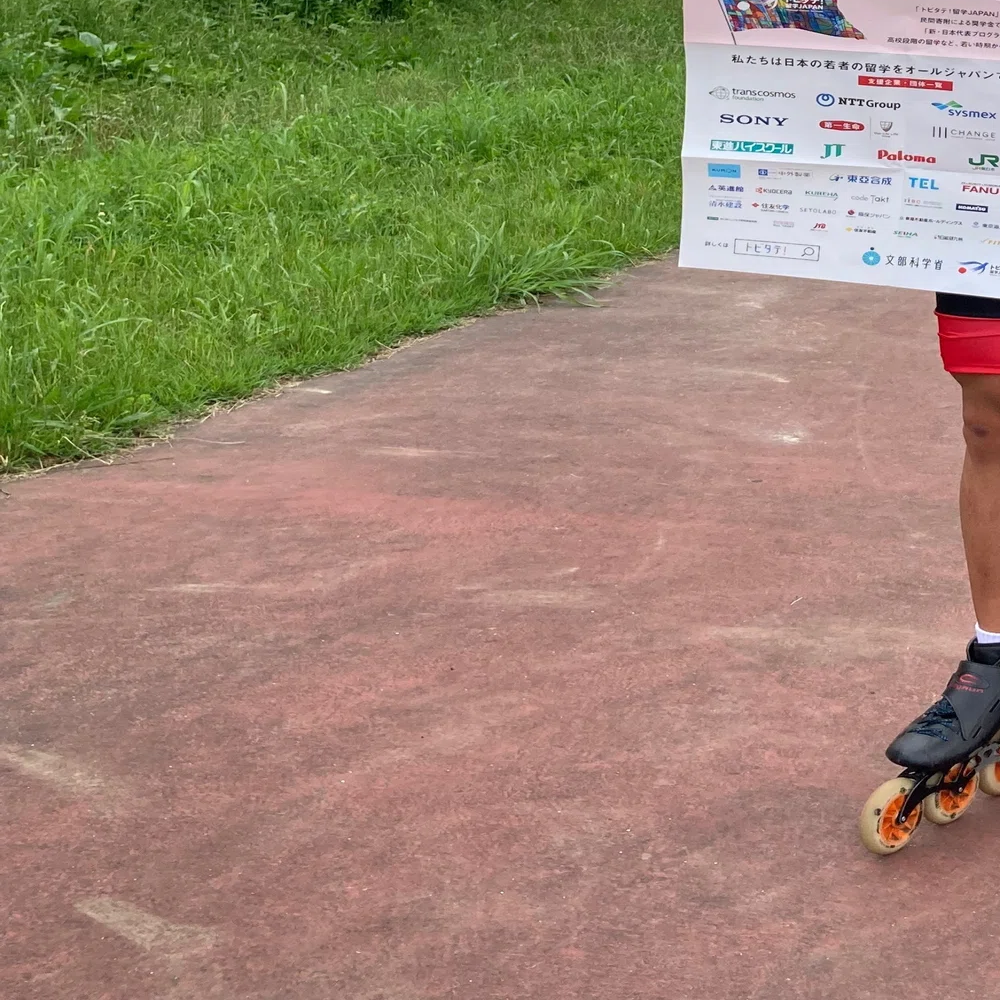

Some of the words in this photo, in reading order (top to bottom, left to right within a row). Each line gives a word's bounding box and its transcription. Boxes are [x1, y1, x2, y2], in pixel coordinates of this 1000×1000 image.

[867, 78, 943, 89] 支援企業・団体一覧
[732, 87, 796, 99] transcosmos
[719, 113, 789, 127] SONY
[948, 108, 997, 120] sysmex
[824, 121, 861, 131] 第一生命
[951, 128, 996, 139] CHANGE
[711, 140, 794, 154] 東進ハイスクール
[820, 143, 846, 159] JT
[877, 150, 936, 164] Paloma
[968, 153, 1000, 168] JR
[847, 175, 893, 186] 東亞合成
[908, 177, 940, 190] TEL
[745, 242, 787, 255] トビタテ!
[885, 254, 943, 270] 文部科学省
